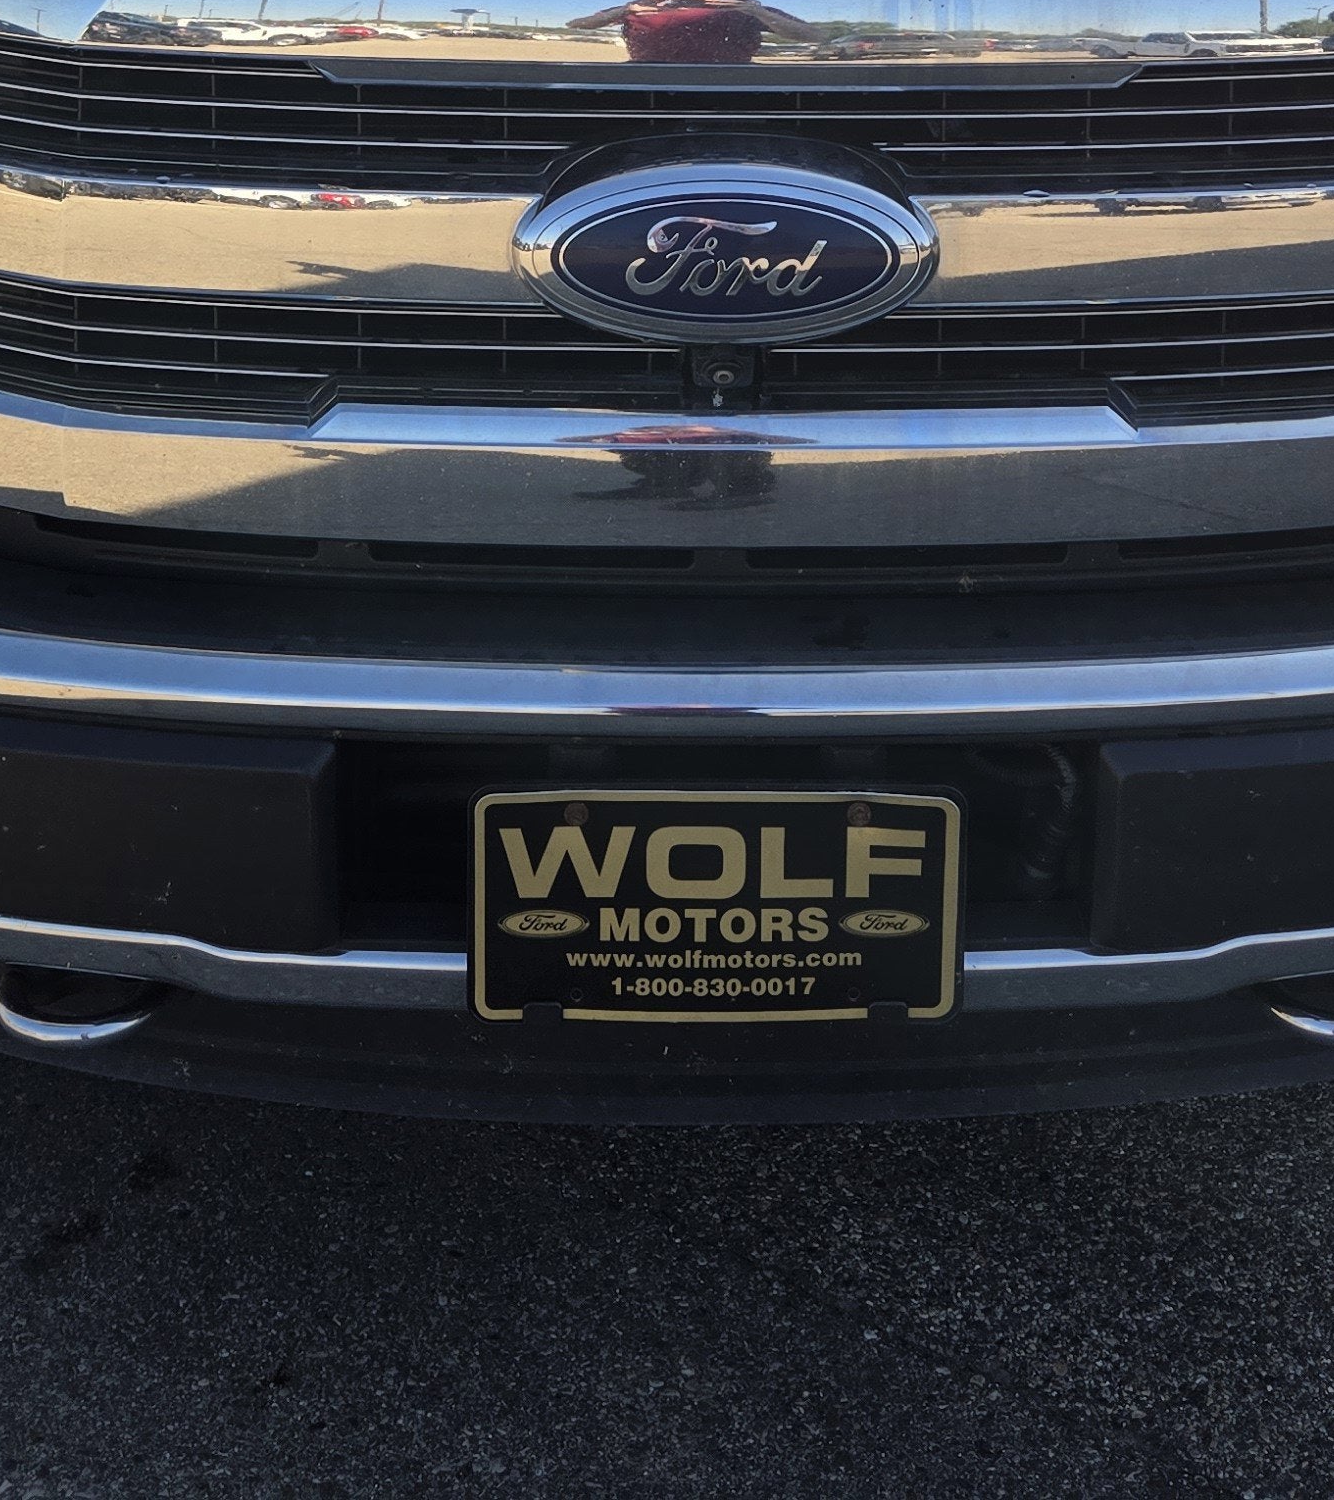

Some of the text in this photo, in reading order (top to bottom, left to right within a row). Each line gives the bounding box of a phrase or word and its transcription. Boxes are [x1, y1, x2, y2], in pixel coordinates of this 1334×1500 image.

[625, 215, 828, 297] Ford
[498, 826, 926, 899] WOLF
[518, 913, 569, 931] Ford
[599, 907, 830, 942] MOTORS
[859, 913, 909, 931] Ford
[566, 949, 863, 969] www.wolfmotors.com
[611, 977, 816, 996] 1-800-830-0017
